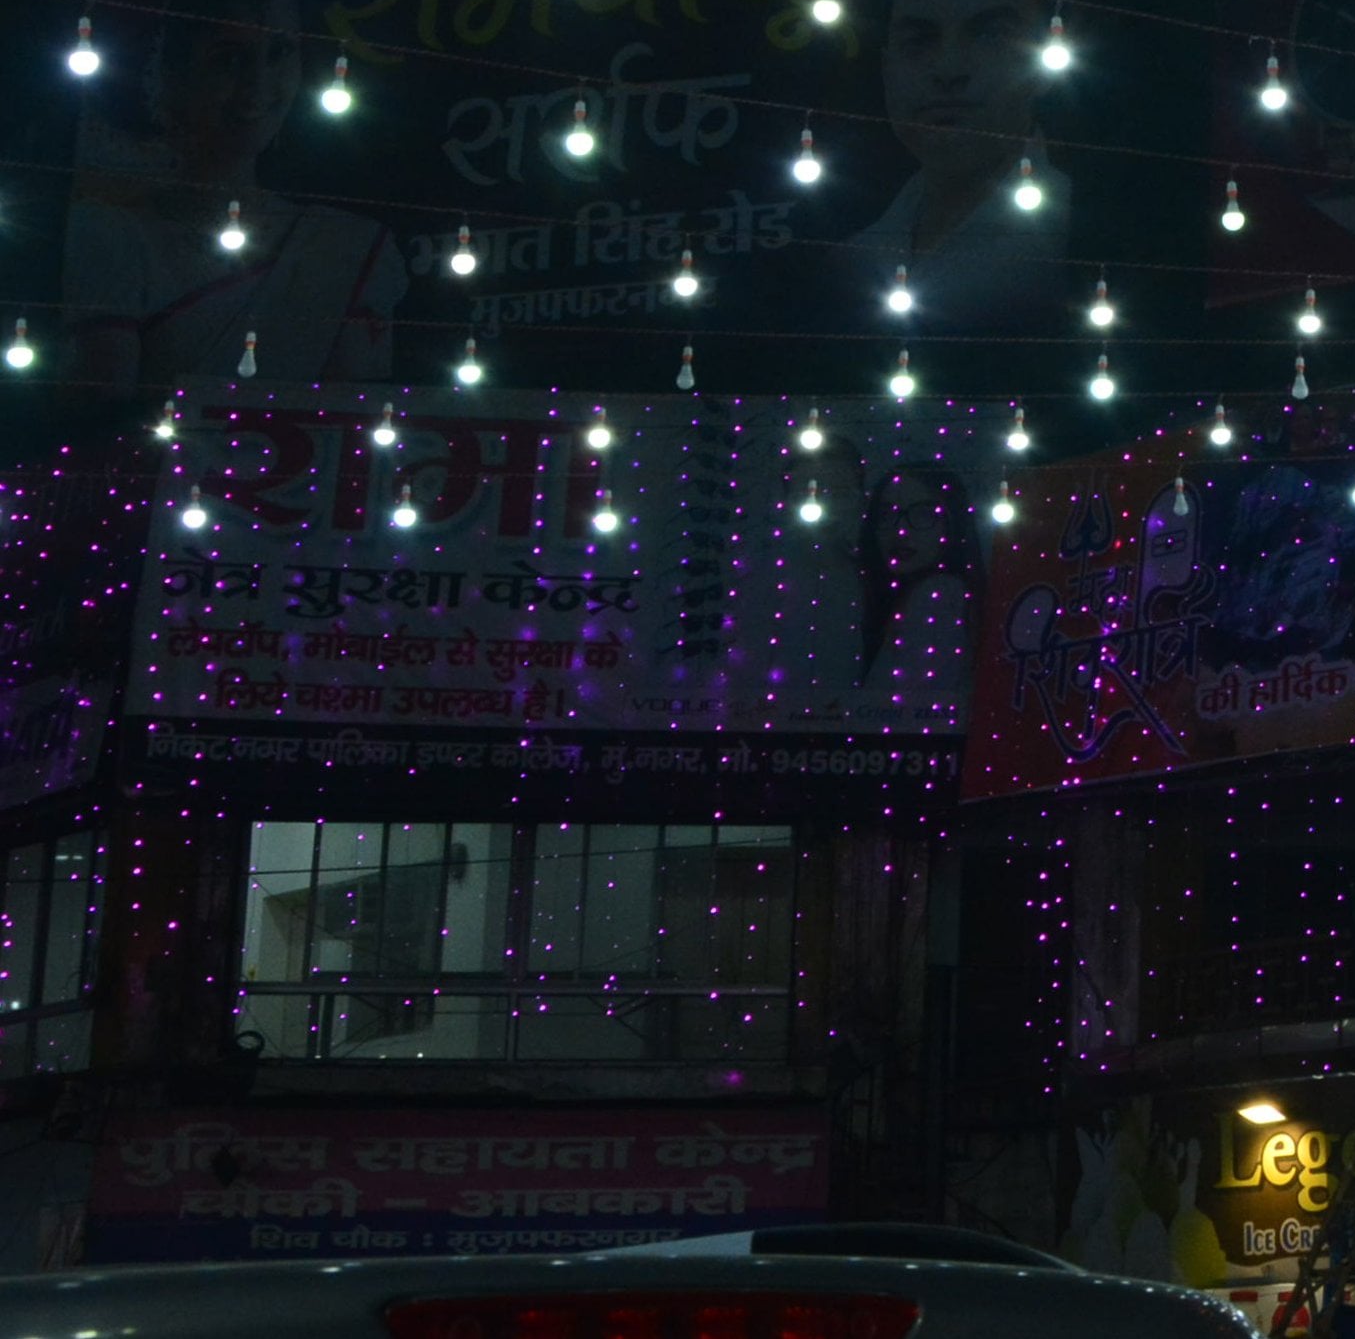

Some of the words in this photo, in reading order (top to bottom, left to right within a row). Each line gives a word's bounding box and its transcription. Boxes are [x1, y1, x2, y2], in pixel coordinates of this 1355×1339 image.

[573, 197, 687, 267] सिंह
[701, 188, 796, 255] रोड
[160, 547, 268, 601] नेत्र
[282, 562, 467, 620] सुरक्षा
[481, 559, 644, 616] केन्द्र
[445, 628, 480, 665] से
[485, 638, 574, 681] सुरक्षा
[294, 681, 384, 715] चश्मा
[1200, 673, 1240, 716] की
[351, 1134, 637, 1174] सहायता
[653, 1121, 823, 1177] केन्द्र
[450, 1174, 752, 1217] आबकारी
[250, 1223, 321, 1250] शिव
